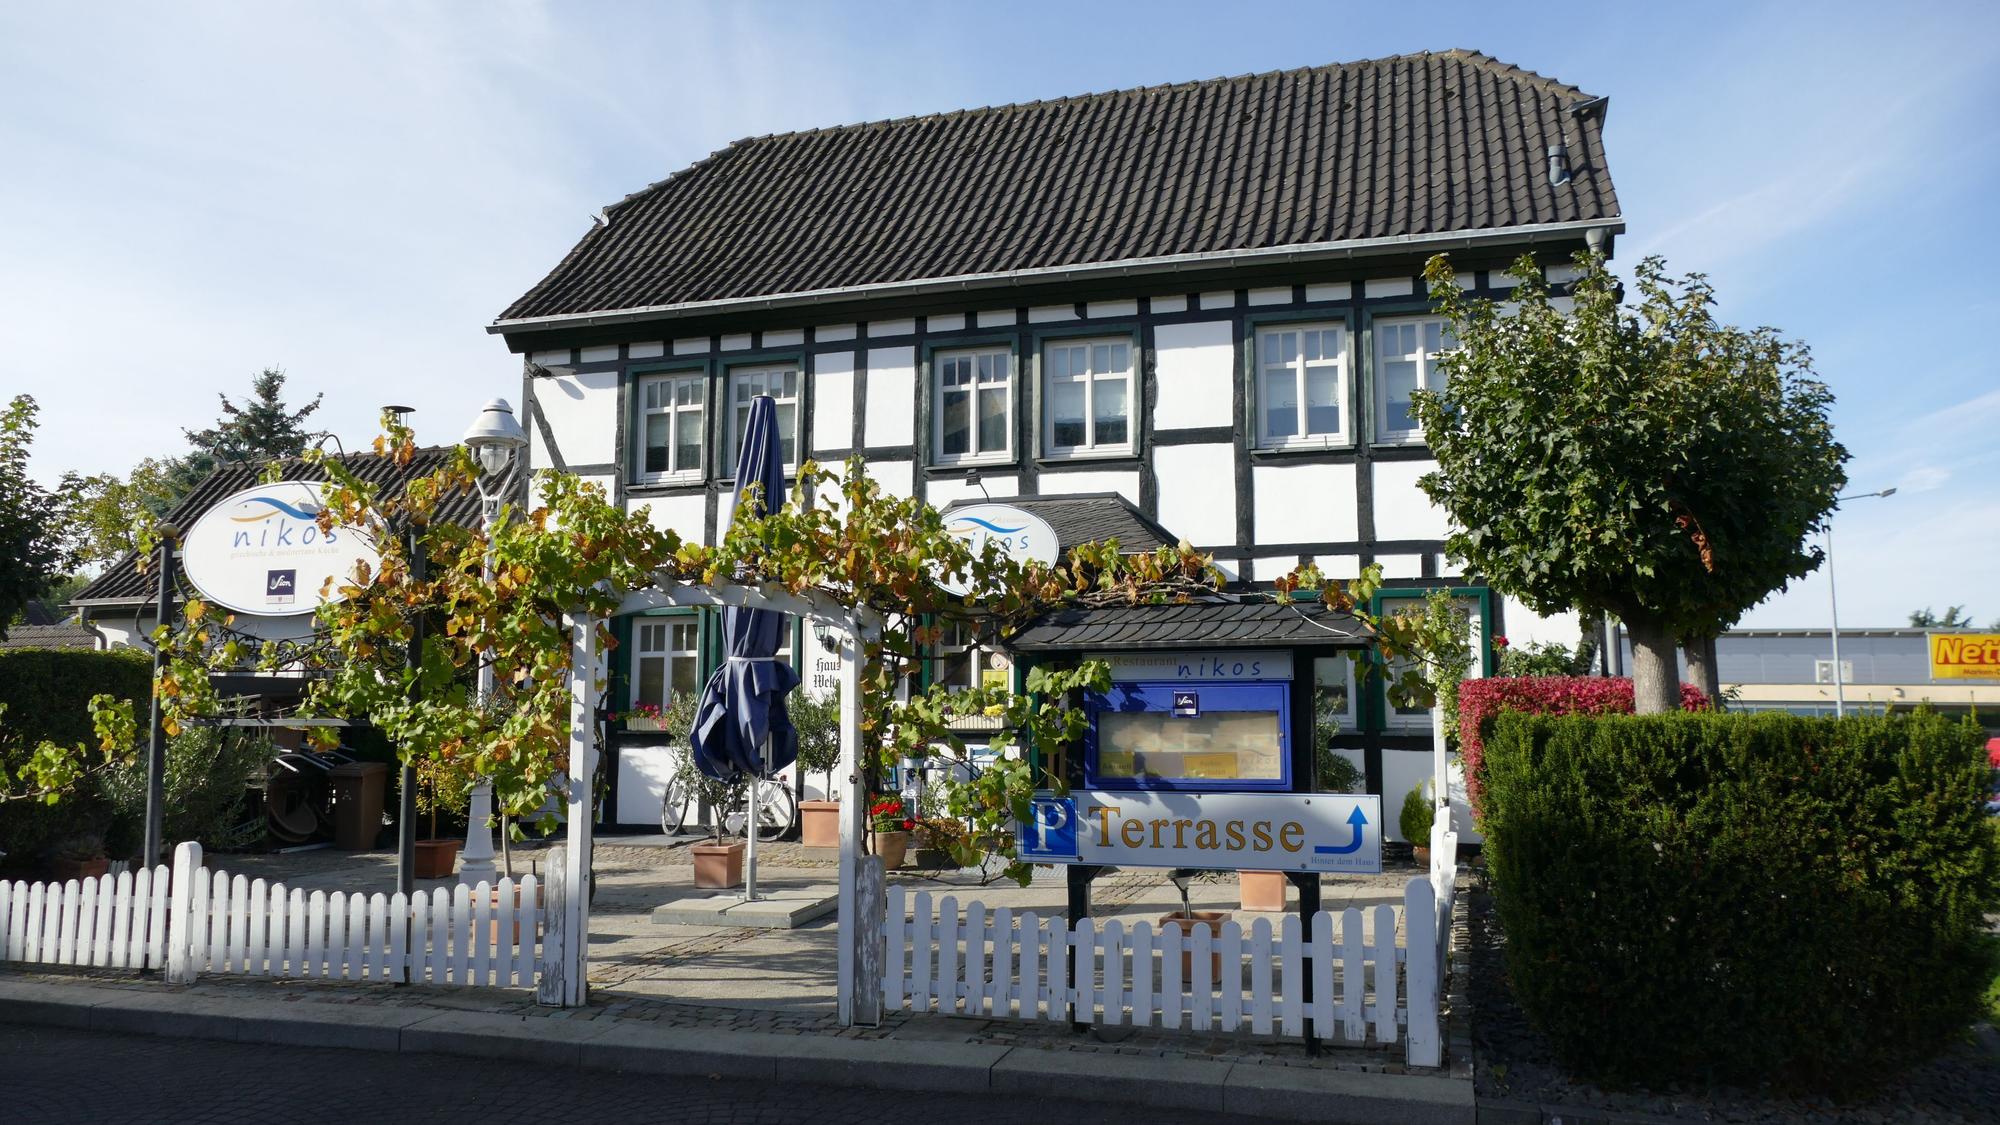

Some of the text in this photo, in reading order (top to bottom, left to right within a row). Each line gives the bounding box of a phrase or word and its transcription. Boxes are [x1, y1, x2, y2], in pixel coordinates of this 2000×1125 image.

[234, 518, 337, 548] nikos
[1936, 638, 2000, 664] Net
[1113, 657, 1261, 677] Restaurant nikos
[1032, 801, 1305, 853] P Terrasse
[1311, 856, 1374, 866] Hinter dem Haus
